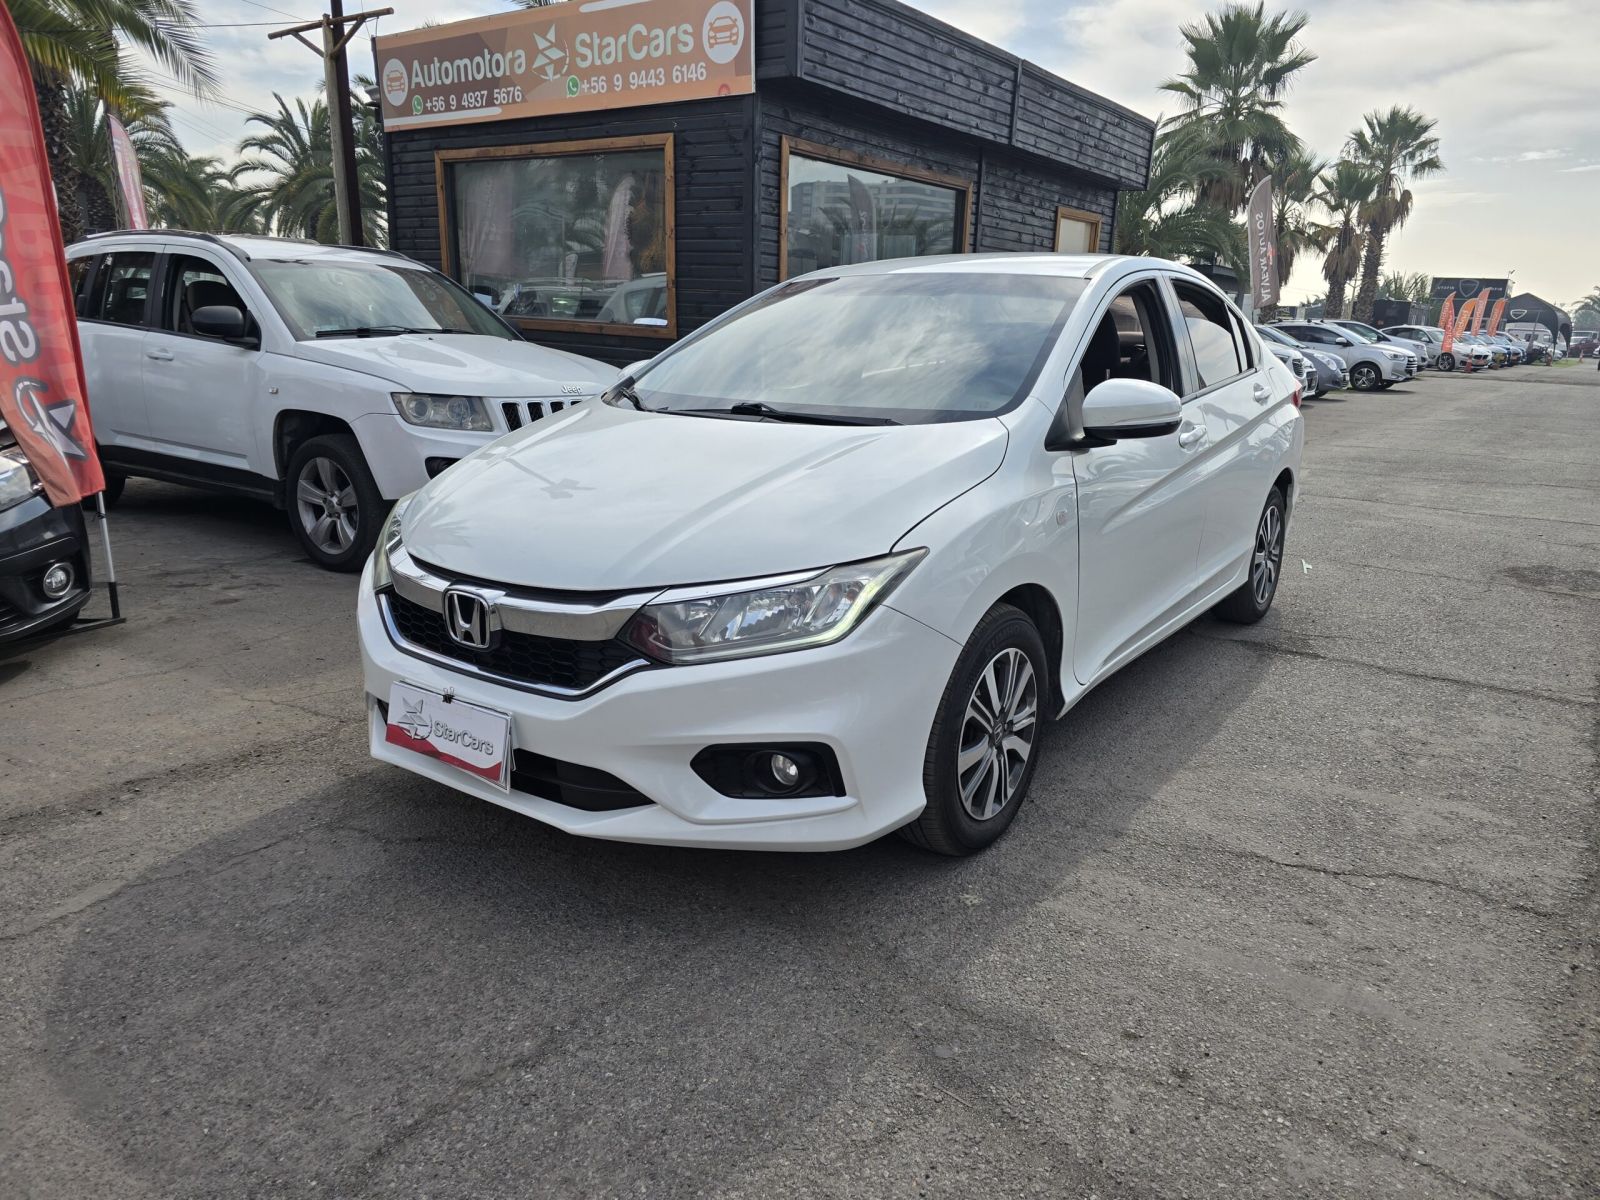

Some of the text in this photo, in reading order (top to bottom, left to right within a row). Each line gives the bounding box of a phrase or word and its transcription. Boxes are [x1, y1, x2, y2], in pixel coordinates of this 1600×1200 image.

[411, 23, 694, 88] Automotora StarCars
[582, 62, 707, 94] +56 9 9443 6146
[425, 86, 522, 112] +56 9 4937 5676
[561, 384, 583, 395] Jeep
[434, 720, 493, 755] StarCars
